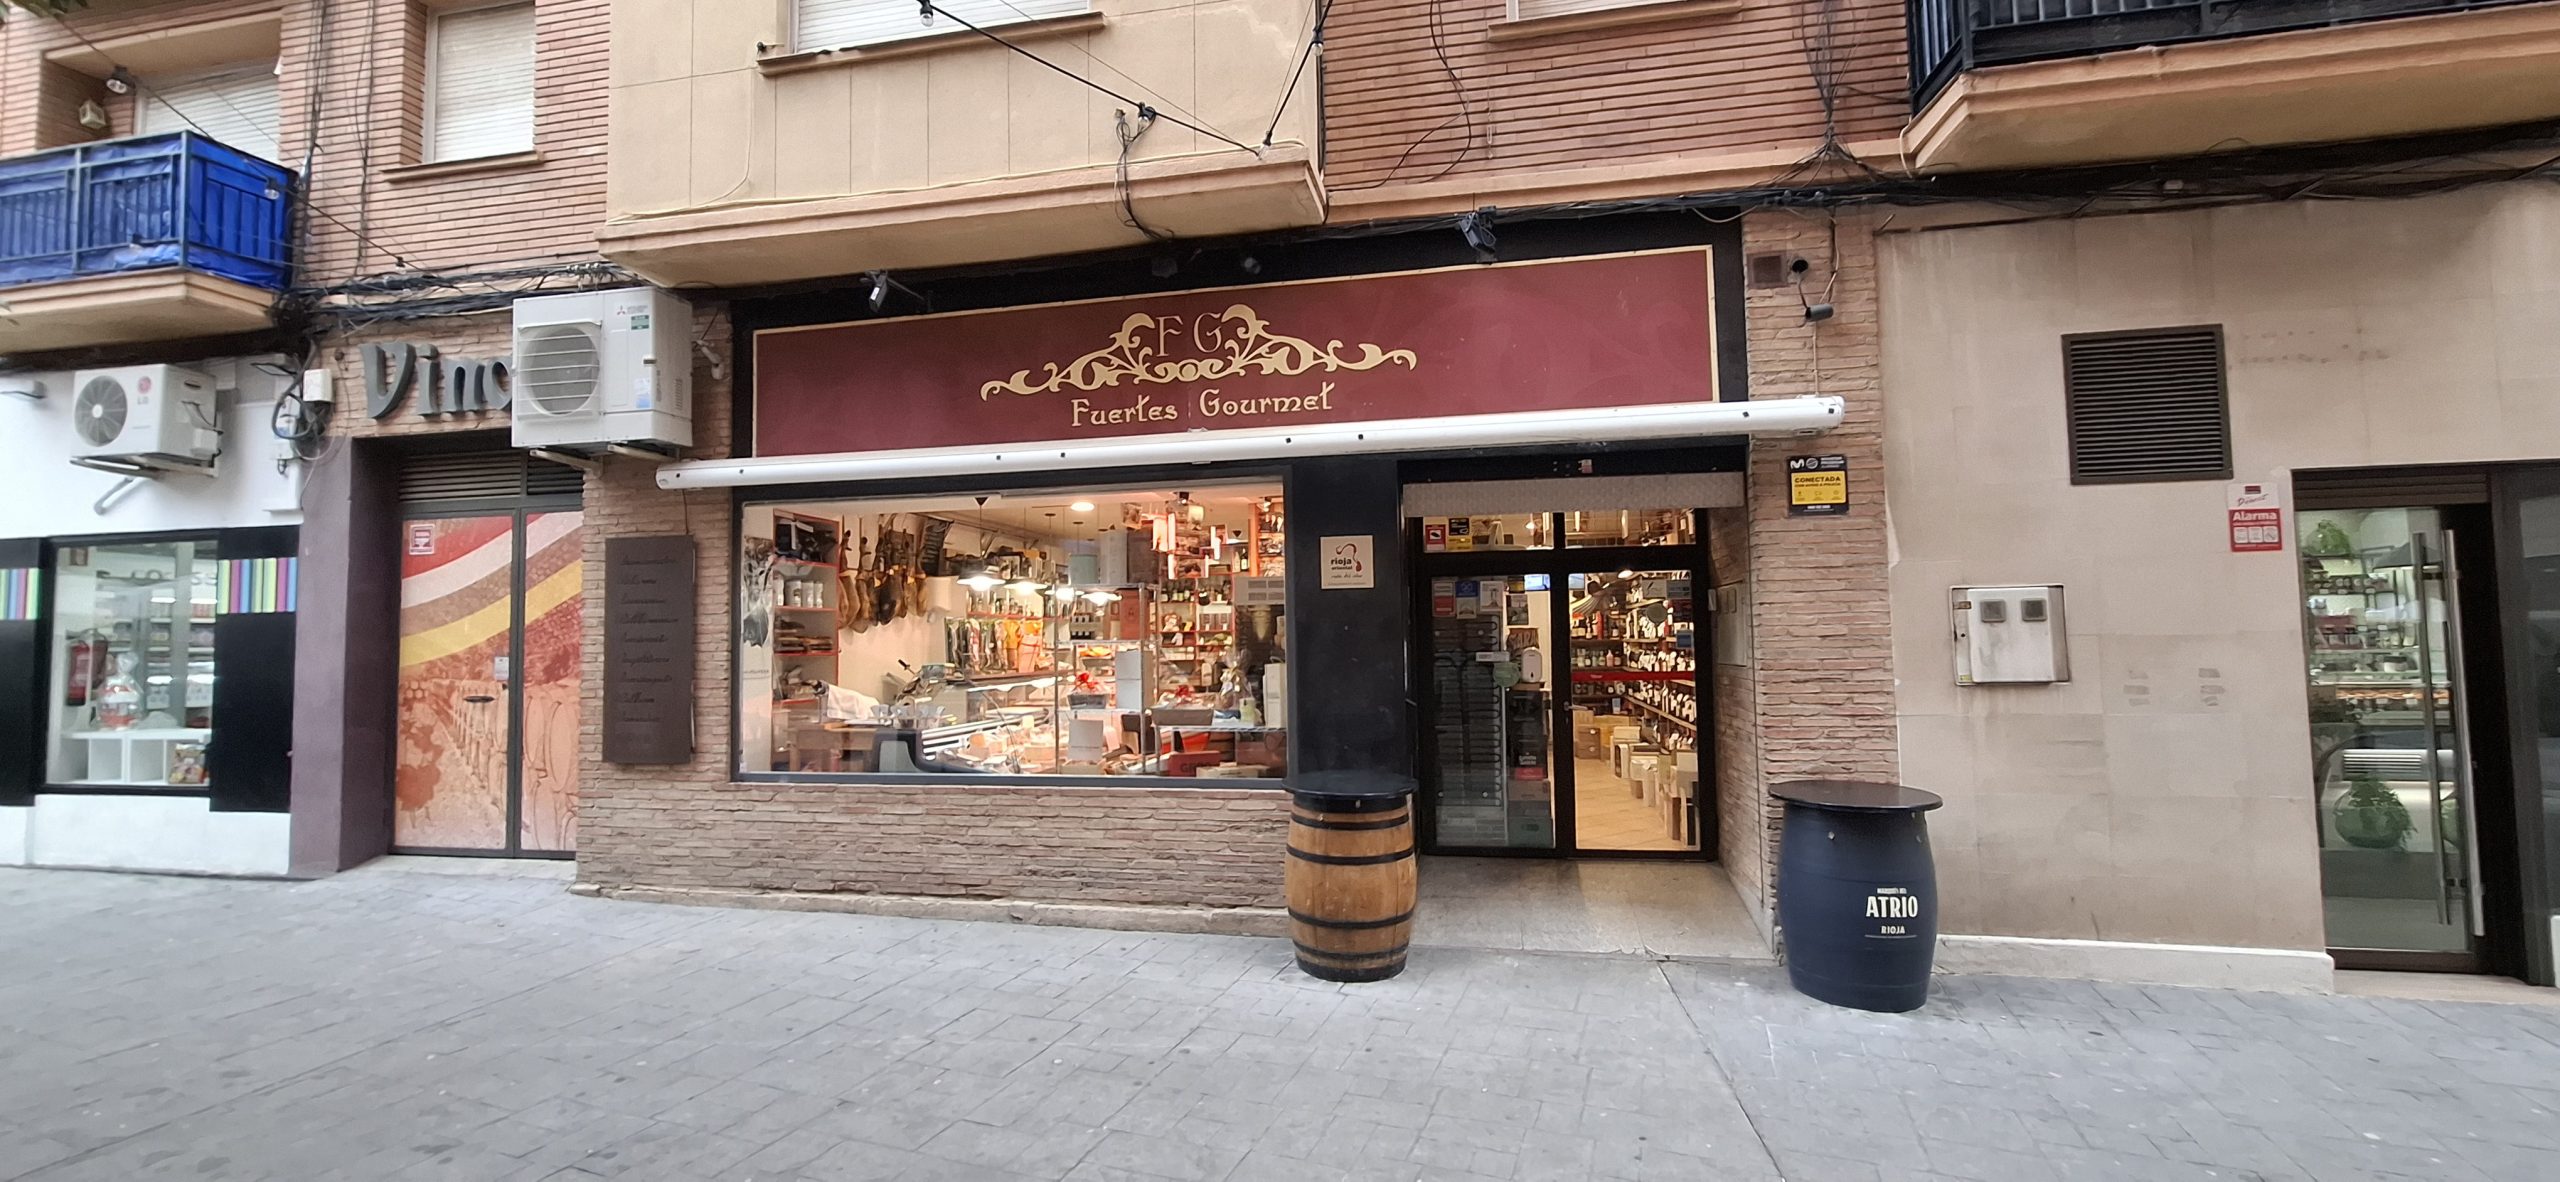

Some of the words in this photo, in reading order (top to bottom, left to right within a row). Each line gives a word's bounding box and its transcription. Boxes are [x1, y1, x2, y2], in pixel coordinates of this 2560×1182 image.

[1155, 315, 1184, 358] F
[1193, 312, 1223, 354] G
[1070, 394, 1178, 427] Fuertes
[1199, 381, 1336, 417] Gourmet
[2233, 511, 2278, 522] Alarma
[1331, 557, 1352, 566] rioja
[1866, 896, 1918, 918] ATRIO
[1881, 925, 1906, 934] RIOJA
